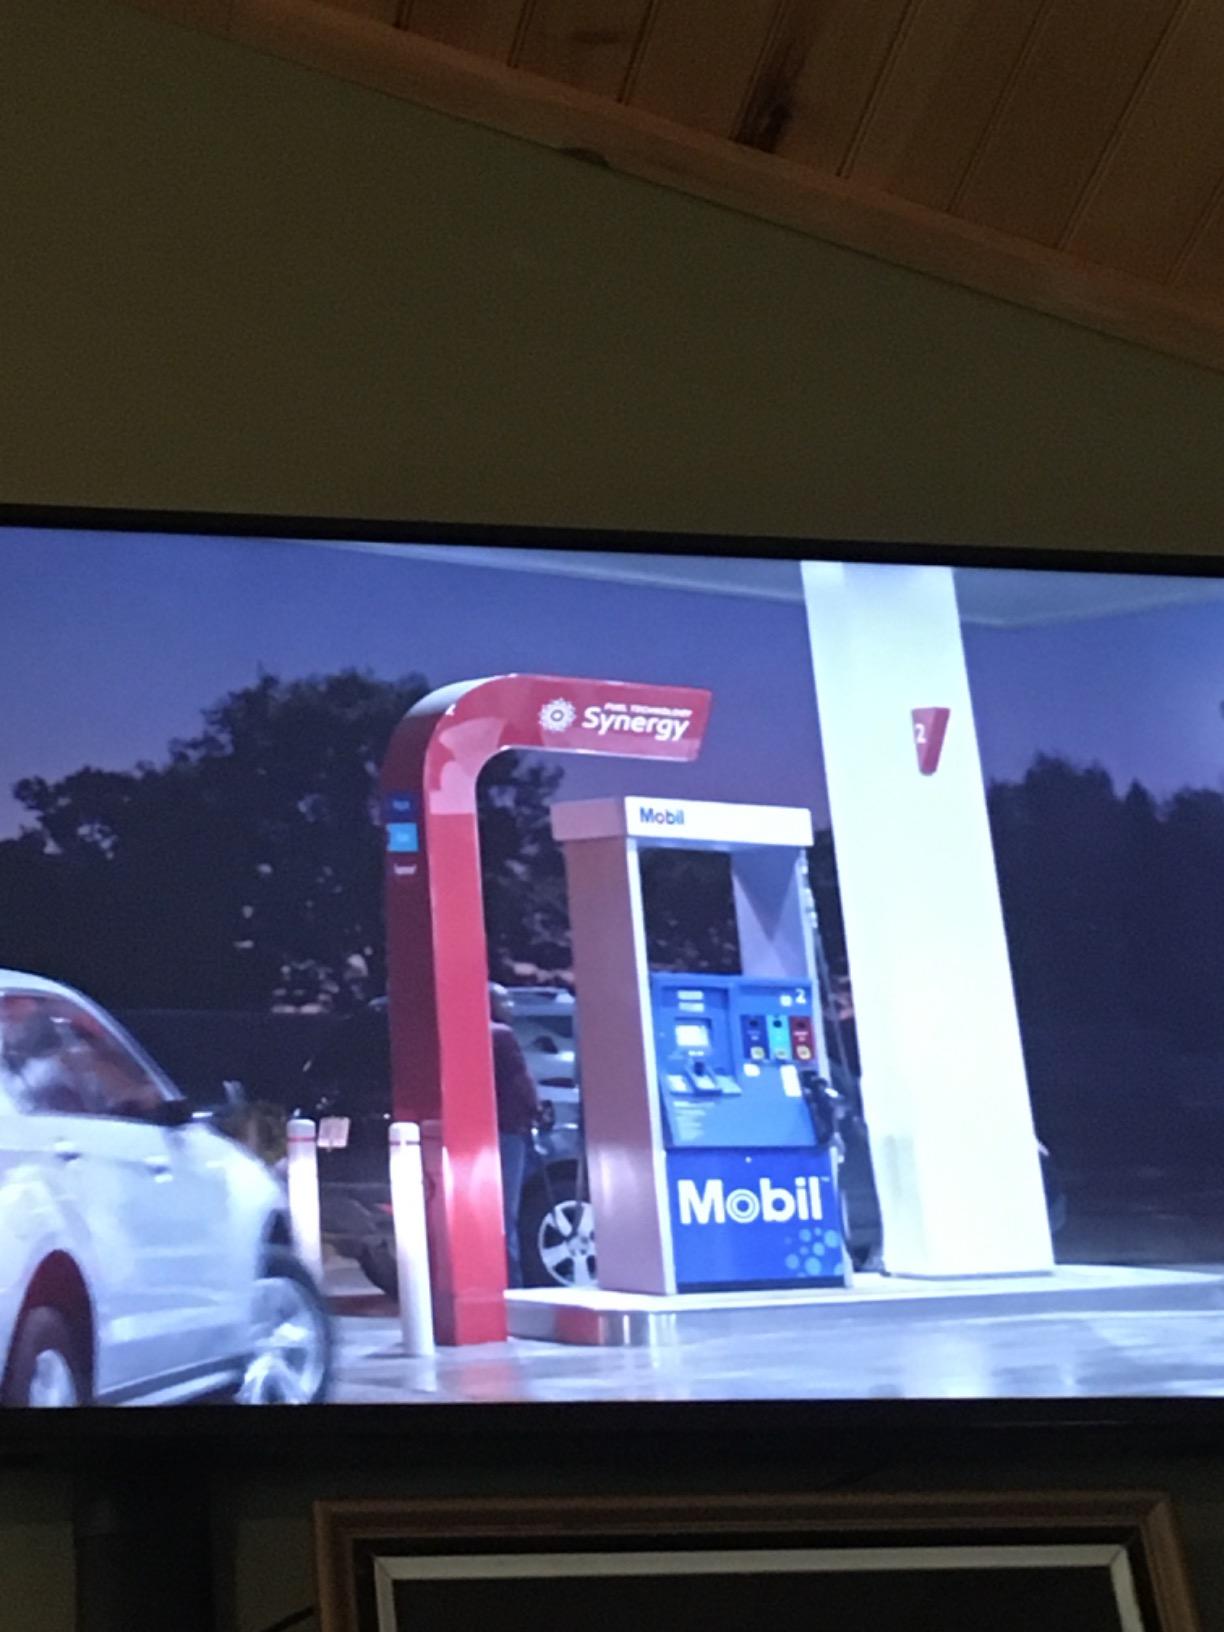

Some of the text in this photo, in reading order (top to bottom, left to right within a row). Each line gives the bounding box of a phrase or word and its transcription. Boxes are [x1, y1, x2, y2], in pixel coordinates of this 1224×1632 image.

[581, 705, 690, 741] Synergy
[915, 723, 927, 744] 2
[639, 806, 685, 825] Mobil
[795, 988, 806, 1004] 2
[677, 1176, 823, 1225] Mobil
